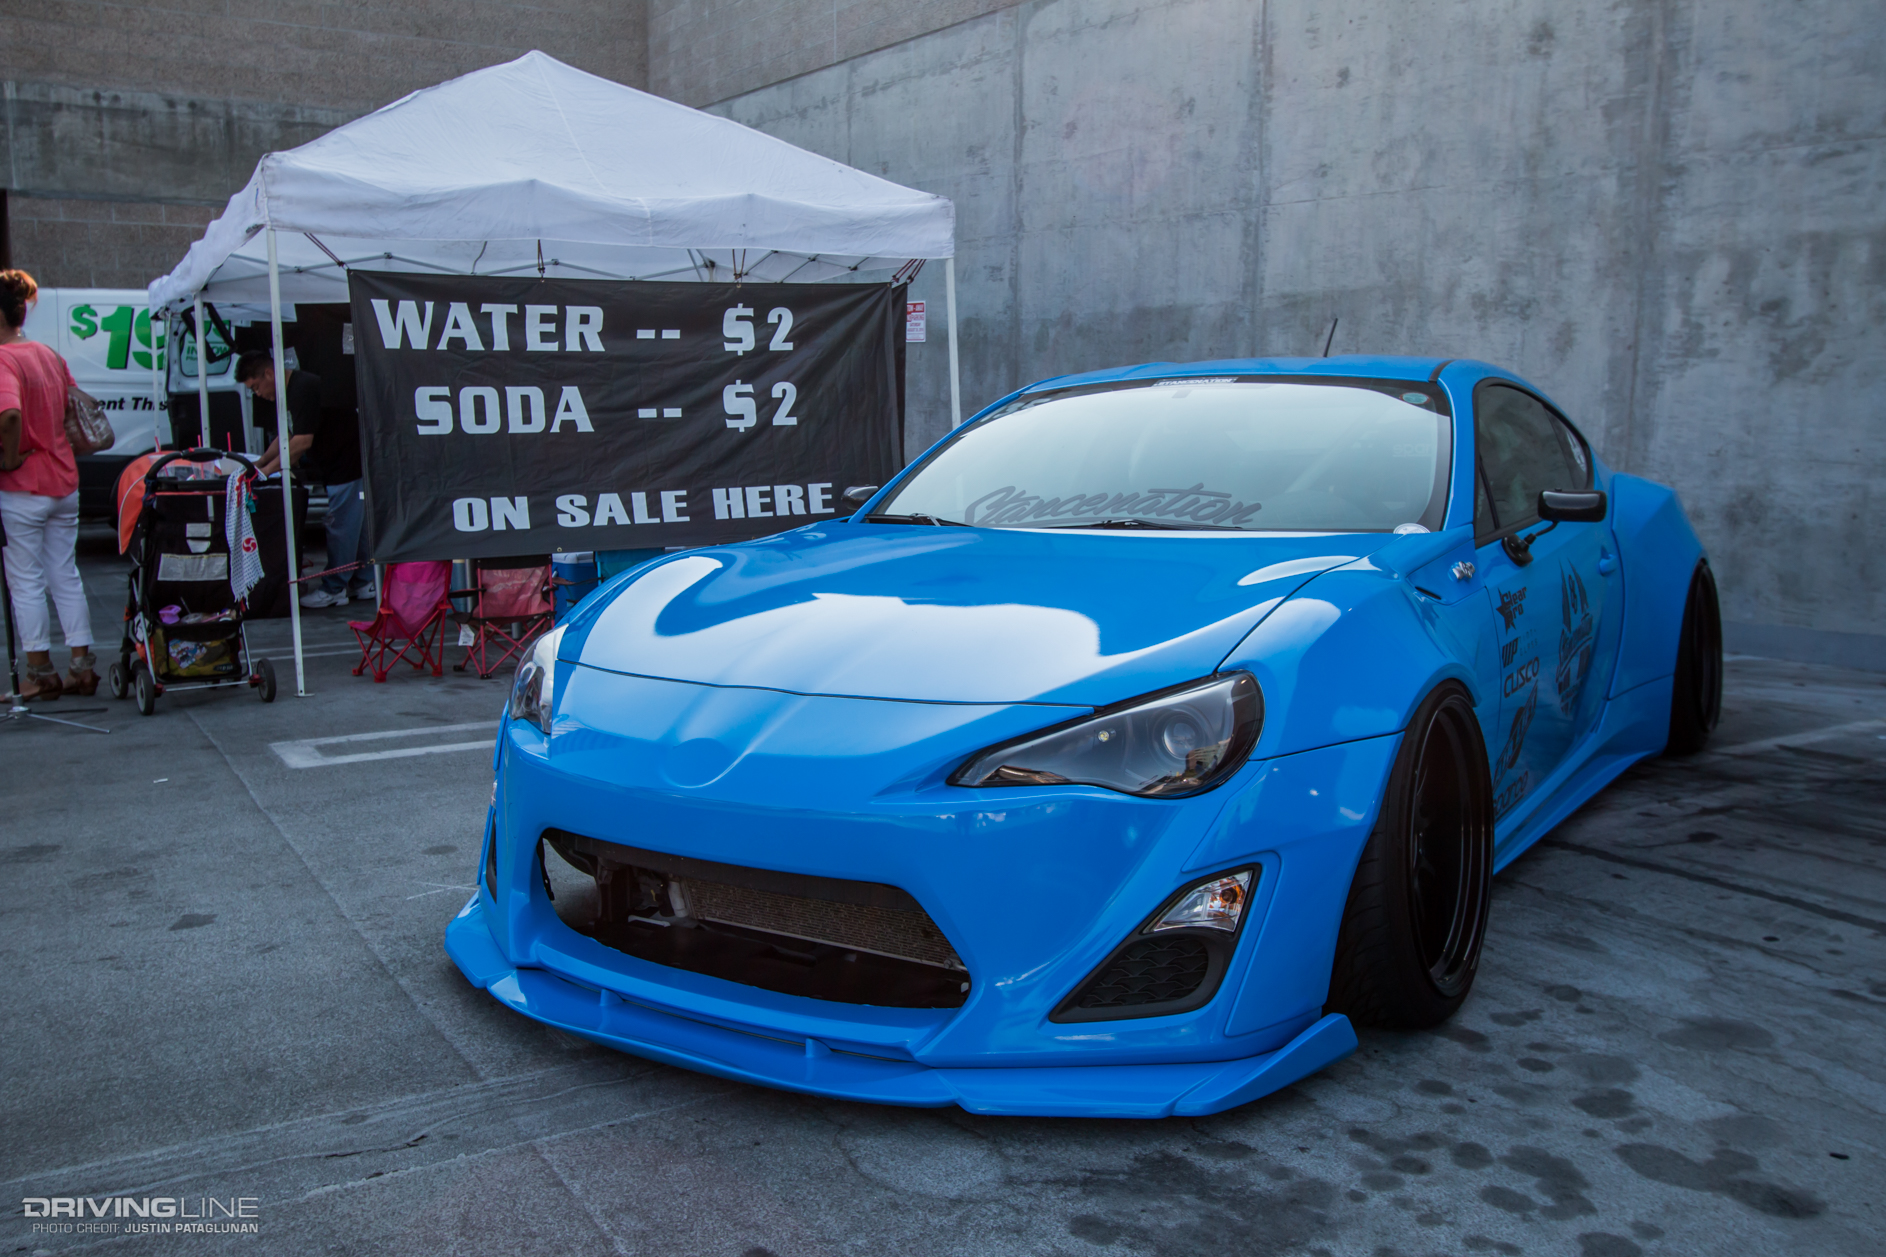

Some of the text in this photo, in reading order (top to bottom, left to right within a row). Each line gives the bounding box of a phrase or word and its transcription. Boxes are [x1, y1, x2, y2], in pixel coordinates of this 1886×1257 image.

[370, 298, 606, 352] WATER
[99, 397, 168, 411] ent Ths
[414, 386, 595, 436] SODA
[452, 483, 836, 533] ON SALE HERE
[1504, 656, 1540, 698] CUSCO
